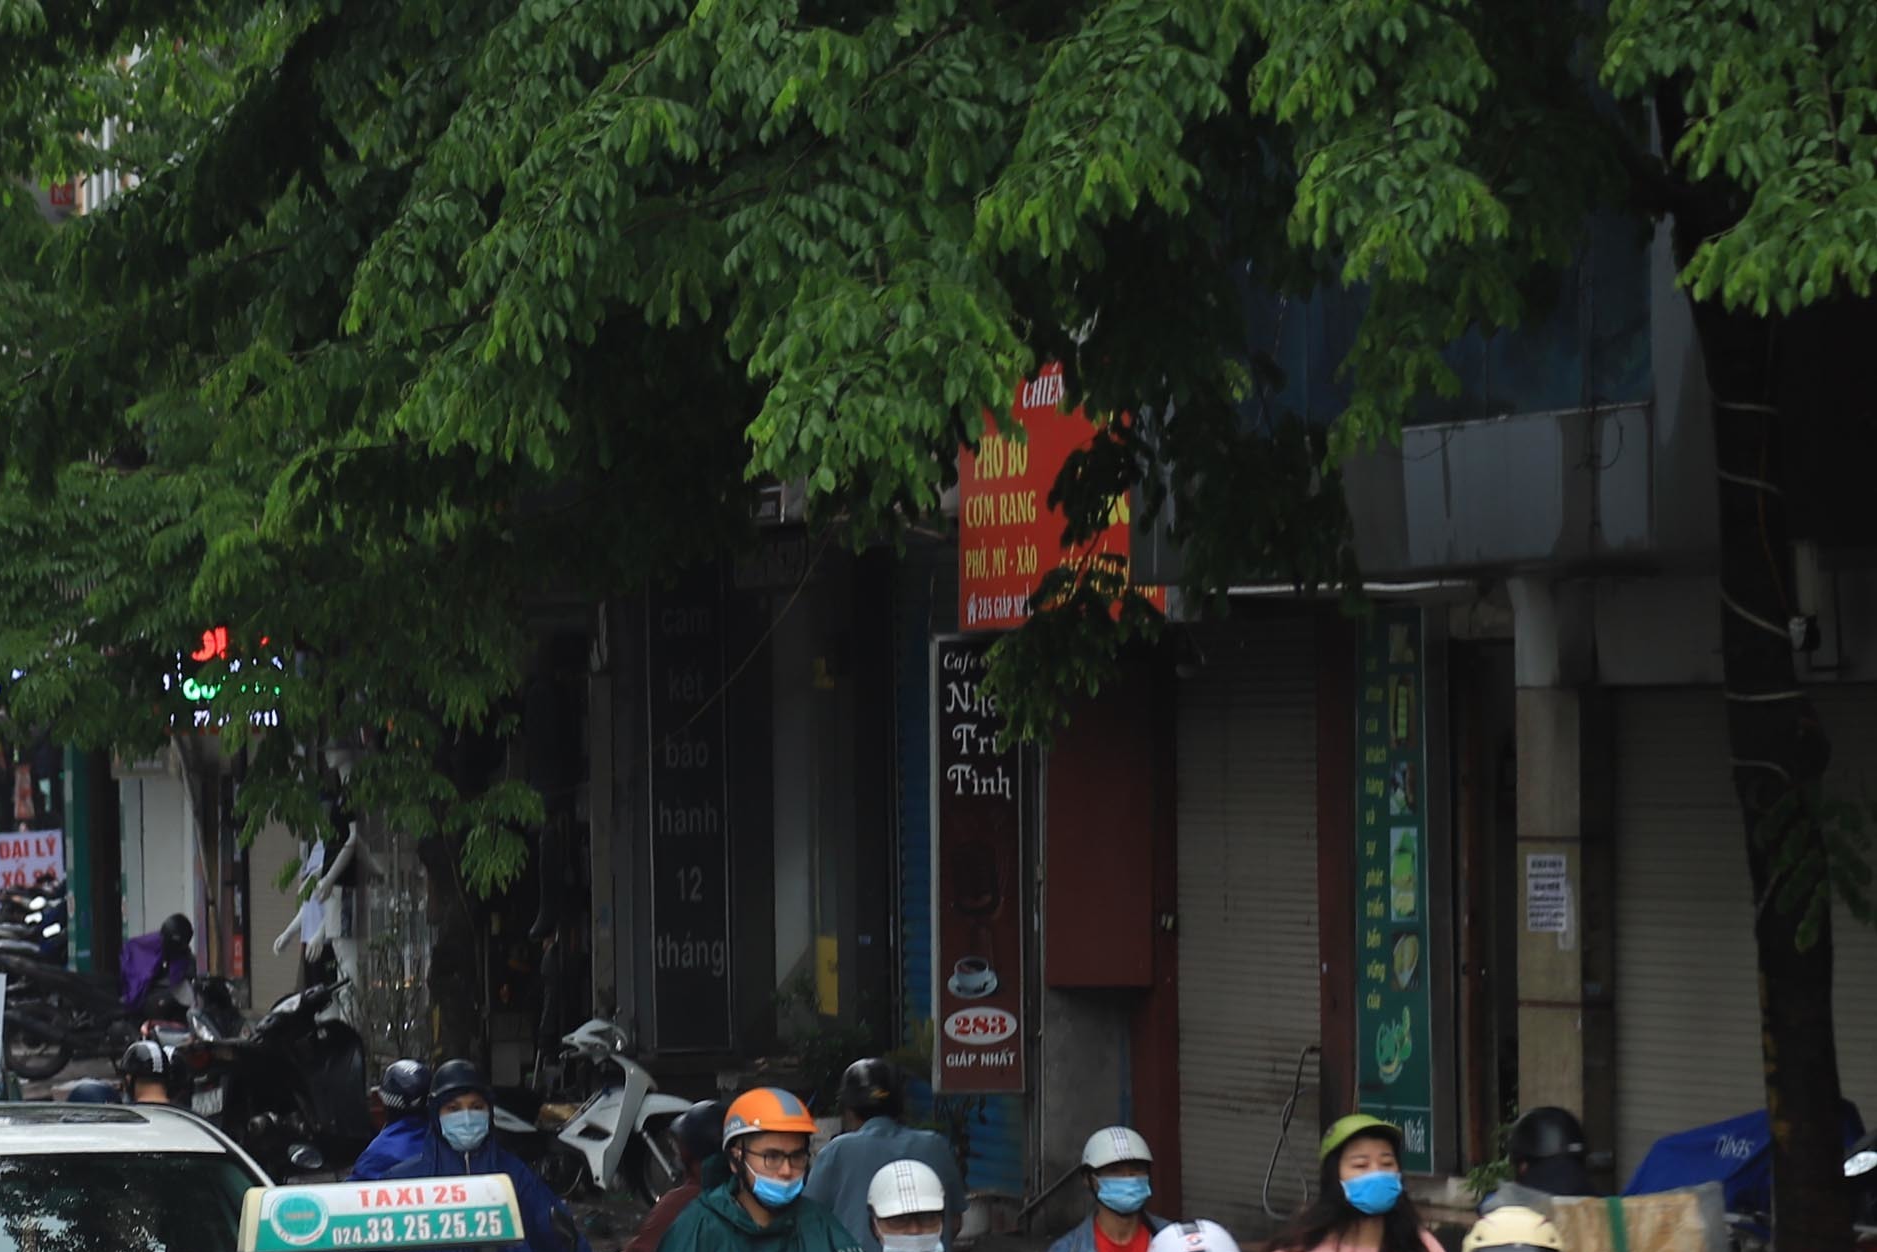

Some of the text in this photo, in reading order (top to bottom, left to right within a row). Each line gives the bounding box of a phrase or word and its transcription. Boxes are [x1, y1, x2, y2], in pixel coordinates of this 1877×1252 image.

[965, 493, 996, 528] CƠM
[999, 490, 1036, 527] RANG
[1016, 536, 1037, 577] XÀO
[946, 763, 1012, 801] Tình
[659, 795, 719, 835] hành
[676, 865, 703, 902] 12
[656, 929, 726, 977] tháng
[954, 1015, 1008, 1036] 283
[946, 1046, 1016, 1068] GIÁP NHẤT
[357, 1183, 468, 1209] TAXI 25
[332, 1210, 502, 1247] 024.33.25.25.25
